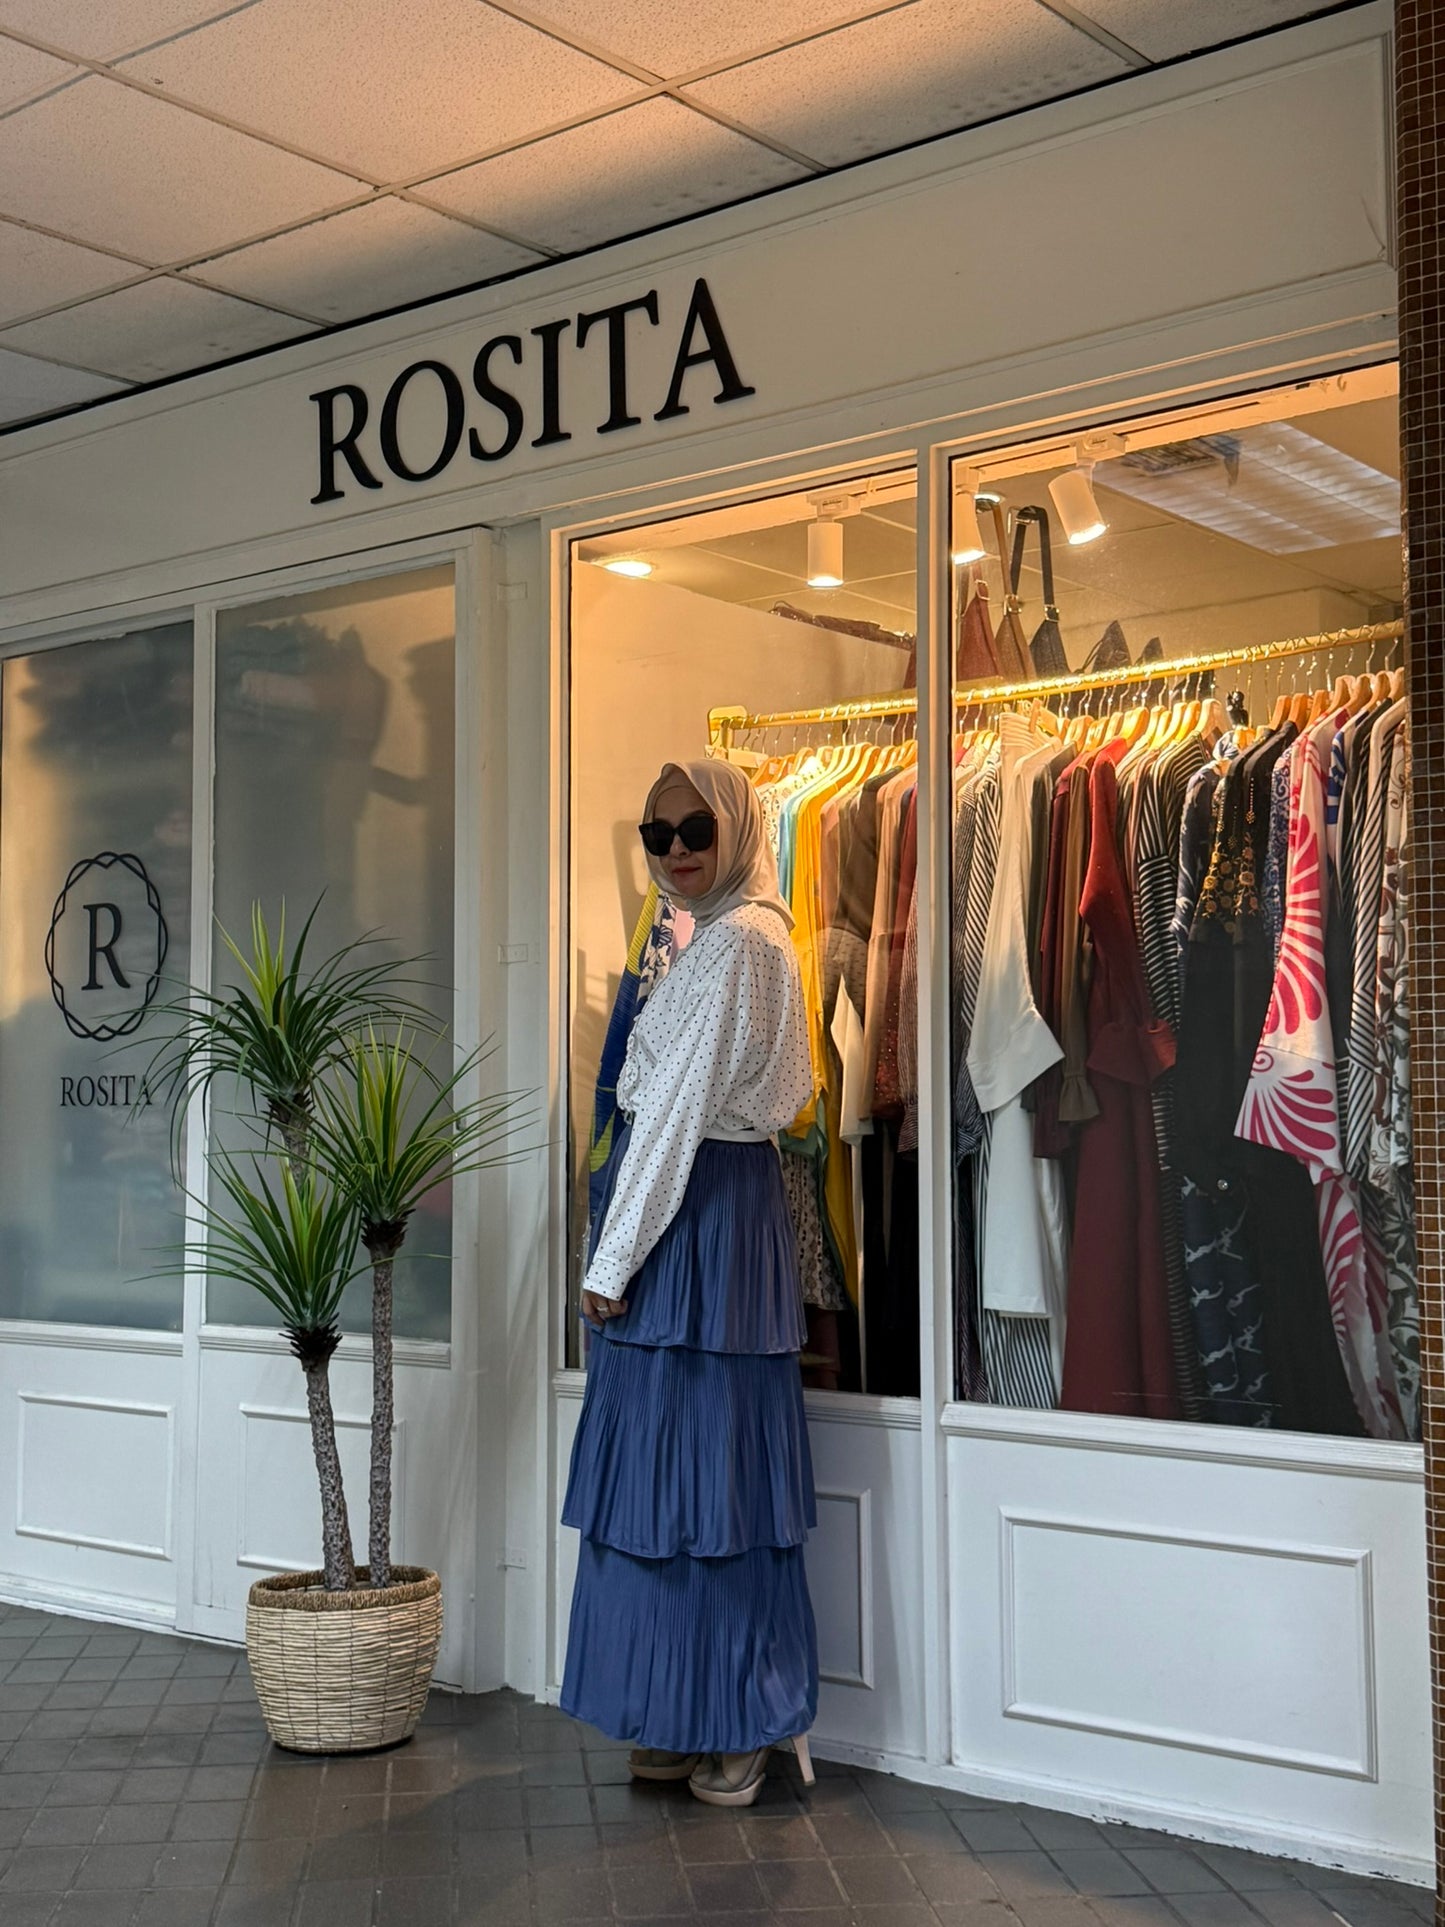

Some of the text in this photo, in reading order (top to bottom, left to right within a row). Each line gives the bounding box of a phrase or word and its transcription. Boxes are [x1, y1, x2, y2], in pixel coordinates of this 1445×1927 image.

[310, 278, 756, 505] ROSITA
[81, 903, 131, 991] R
[60, 1075, 153, 1107] ROSITA
